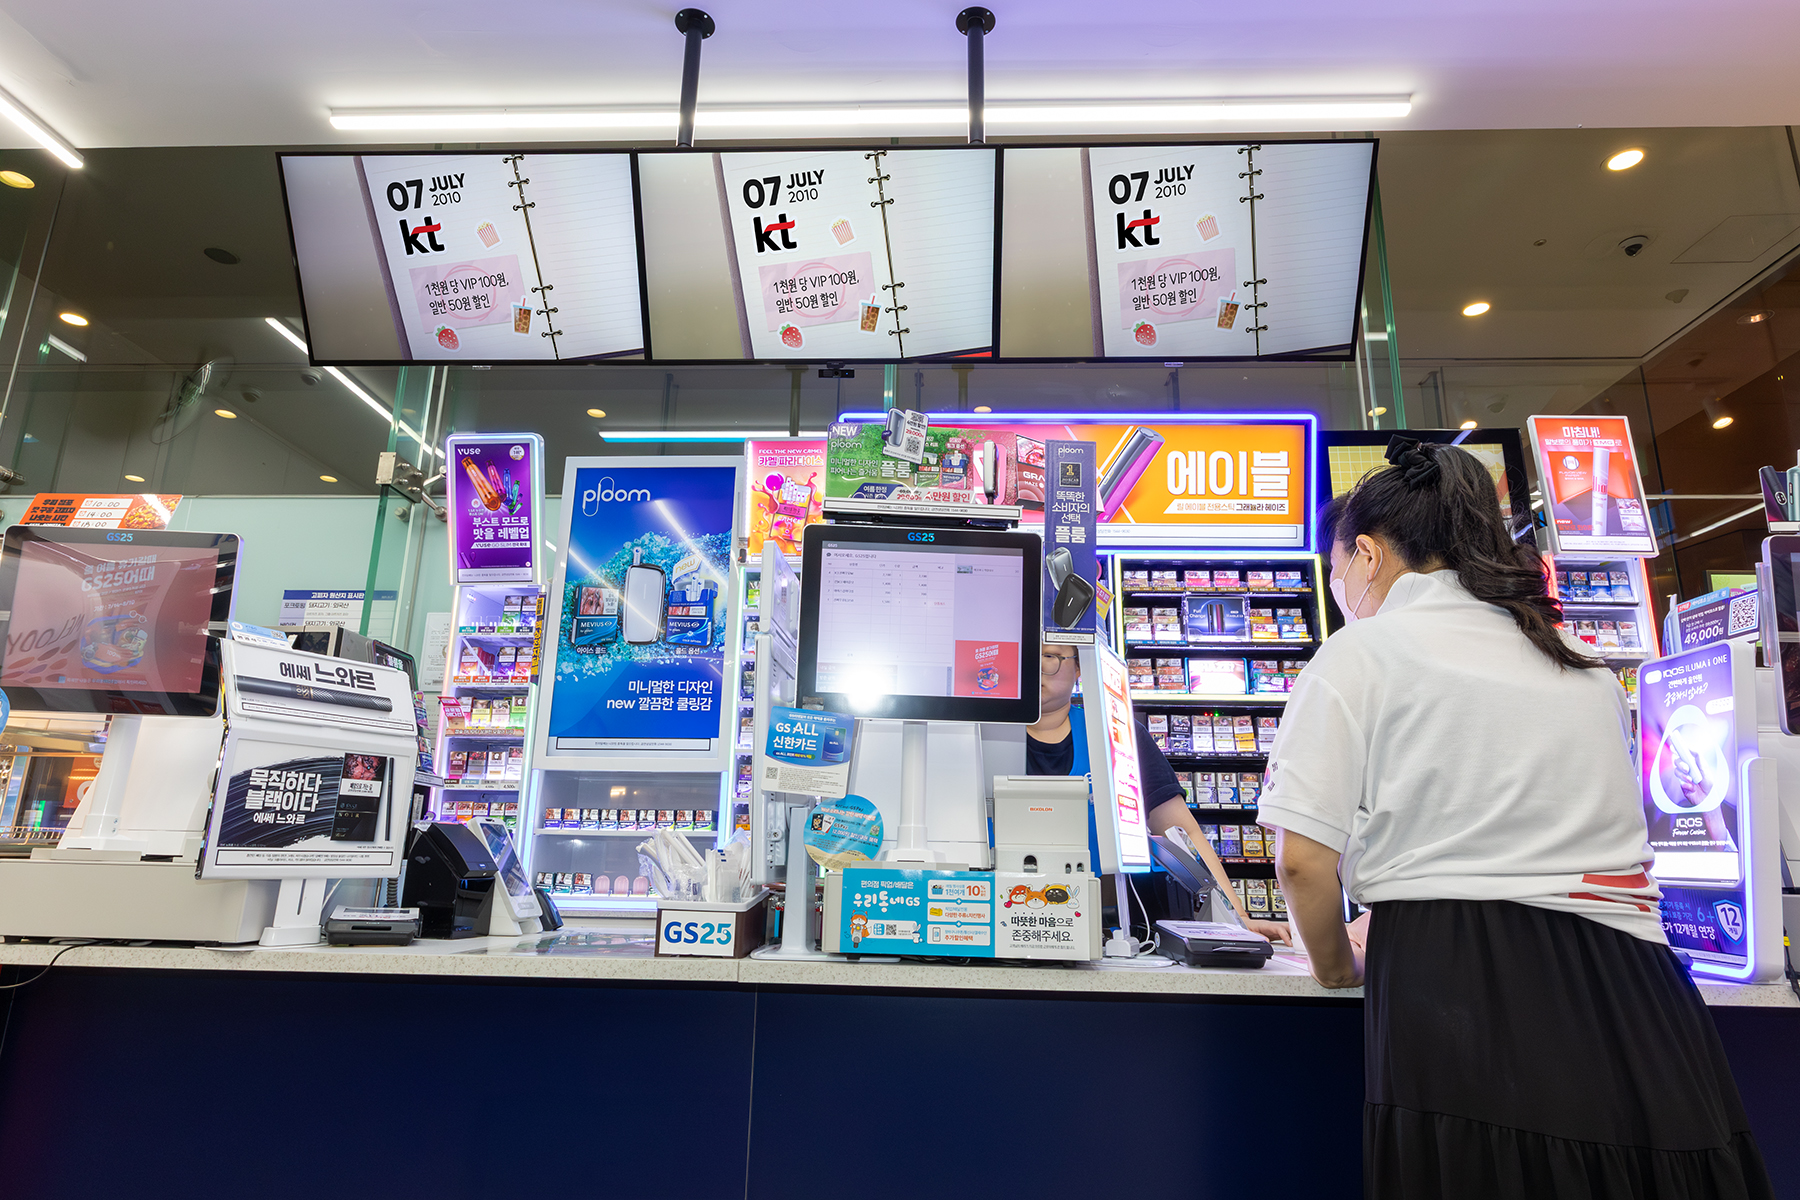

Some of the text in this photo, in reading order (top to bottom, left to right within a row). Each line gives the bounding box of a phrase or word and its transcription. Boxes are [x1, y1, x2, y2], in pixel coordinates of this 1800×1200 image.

[786, 169, 824, 188] JULY
[1154, 164, 1195, 184] JULY
[429, 173, 464, 192] JULY
[1108, 171, 1149, 204] 07
[387, 179, 423, 211] 07
[432, 192, 461, 206] 2010
[743, 176, 781, 209] 07
[788, 188, 818, 203] 2010
[1155, 184, 1186, 198] 2010
[399, 216, 445, 255] kt
[753, 214, 797, 253] kt
[1116, 209, 1160, 249] kt
[425, 272, 509, 296] 1천원 당 VIP 100원,
[774, 270, 860, 294] 1천원 당 VIP 100원,
[1132, 266, 1220, 291] 1천원 당 VIP 100원,
[429, 294, 490, 316] 일반 50원 할인
[776, 292, 838, 314] 일반 50원 할인
[1132, 288, 1197, 310] 일반 50원 할인
[832, 426, 858, 436] NEW
[1562, 426, 1600, 438] 마침내!
[1058, 444, 1084, 458] ploom
[758, 456, 824, 467] 카멜 파라다이스
[858, 459, 878, 468] 디자인
[1167, 450, 1290, 498] 에이블
[583, 477, 650, 516] ploom
[1056, 490, 1086, 502] 똑똑한
[1052, 502, 1090, 514] 소비자의
[472, 516, 530, 528] 부스트 모드로
[1061, 514, 1081, 524] 선택
[106, 532, 134, 542] GS25
[473, 526, 529, 540] 맛을 레벨업
[906, 532, 935, 542] GS25
[1055, 526, 1086, 544] 플룸
[675, 558, 696, 574] new
[1663, 666, 1684, 678] IQOS
[1686, 661, 1706, 672] ILUMA
[1712, 654, 1728, 666] ONE
[280, 662, 376, 690] 에쎄 느와르
[628, 680, 713, 694] 미니멀한 디자인
[606, 697, 712, 712] new 깔끔한 쿨링감
[776, 722, 818, 736] GS ALL
[773, 736, 816, 750] 신한카드
[250, 768, 322, 792] 묵직하다
[244, 789, 318, 812] 블랙이다
[253, 812, 306, 824] 에쎄 느와르
[1676, 818, 1703, 828] IQOS
[861, 880, 914, 889] 편의점 픽업/배달은
[1011, 916, 1074, 928] 따뜻한 마음으로
[1720, 908, 1740, 926] 12
[664, 921, 732, 946] GS25
[1012, 930, 1074, 942] 존중해주세요.
[1674, 923, 1716, 940] 12개월 연장
